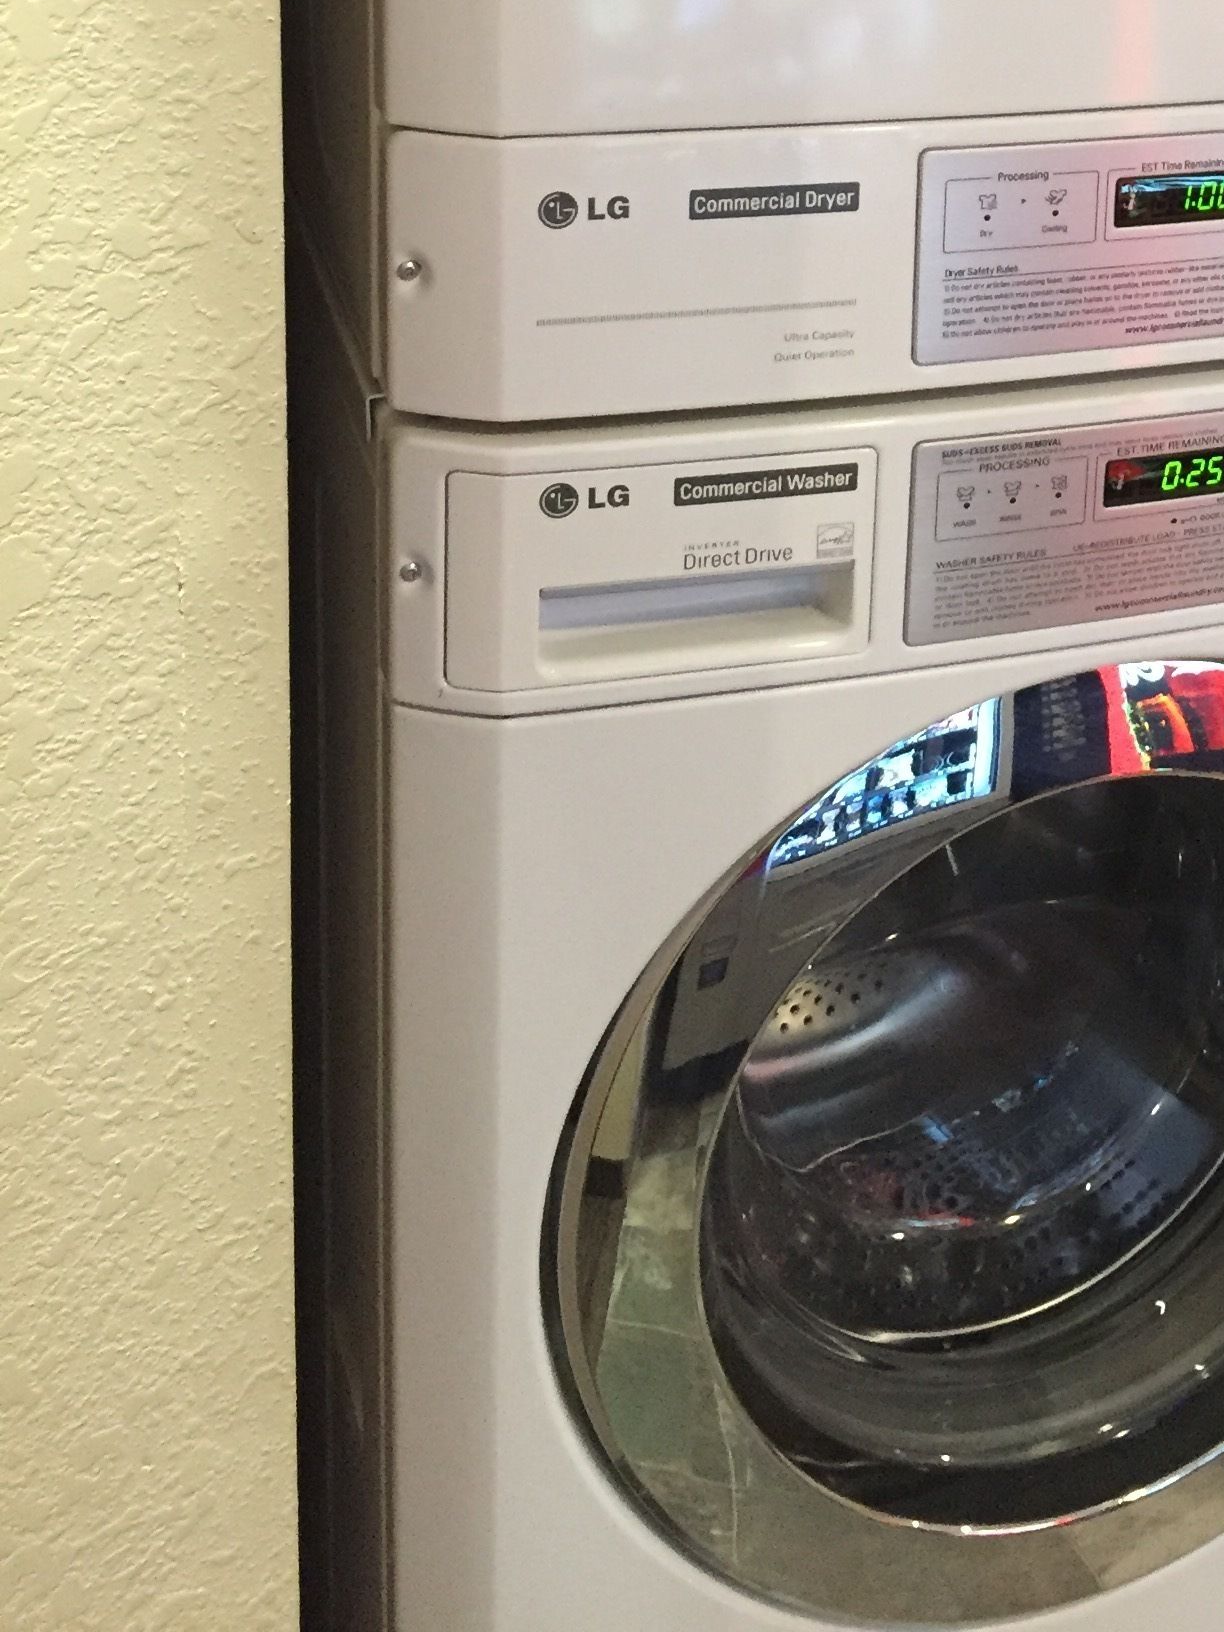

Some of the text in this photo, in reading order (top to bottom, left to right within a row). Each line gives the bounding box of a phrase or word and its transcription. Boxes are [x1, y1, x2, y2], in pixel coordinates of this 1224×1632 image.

[1161, 160, 1183, 171] Time
[997, 170, 1050, 182] Processing
[587, 190, 856, 221] LG Commercial Dryer
[944, 268, 966, 279] Dryer
[967, 267, 995, 276] Safety
[773, 348, 855, 362] Quiet Operation
[1141, 444, 1164, 454] TIME
[979, 457, 1050, 473] PROCESSING
[1161, 455, 1223, 491] 0.25
[588, 471, 854, 509] LG Commercial Washer
[683, 546, 794, 571] Direct Drive
[936, 557, 977, 569] WASHER
